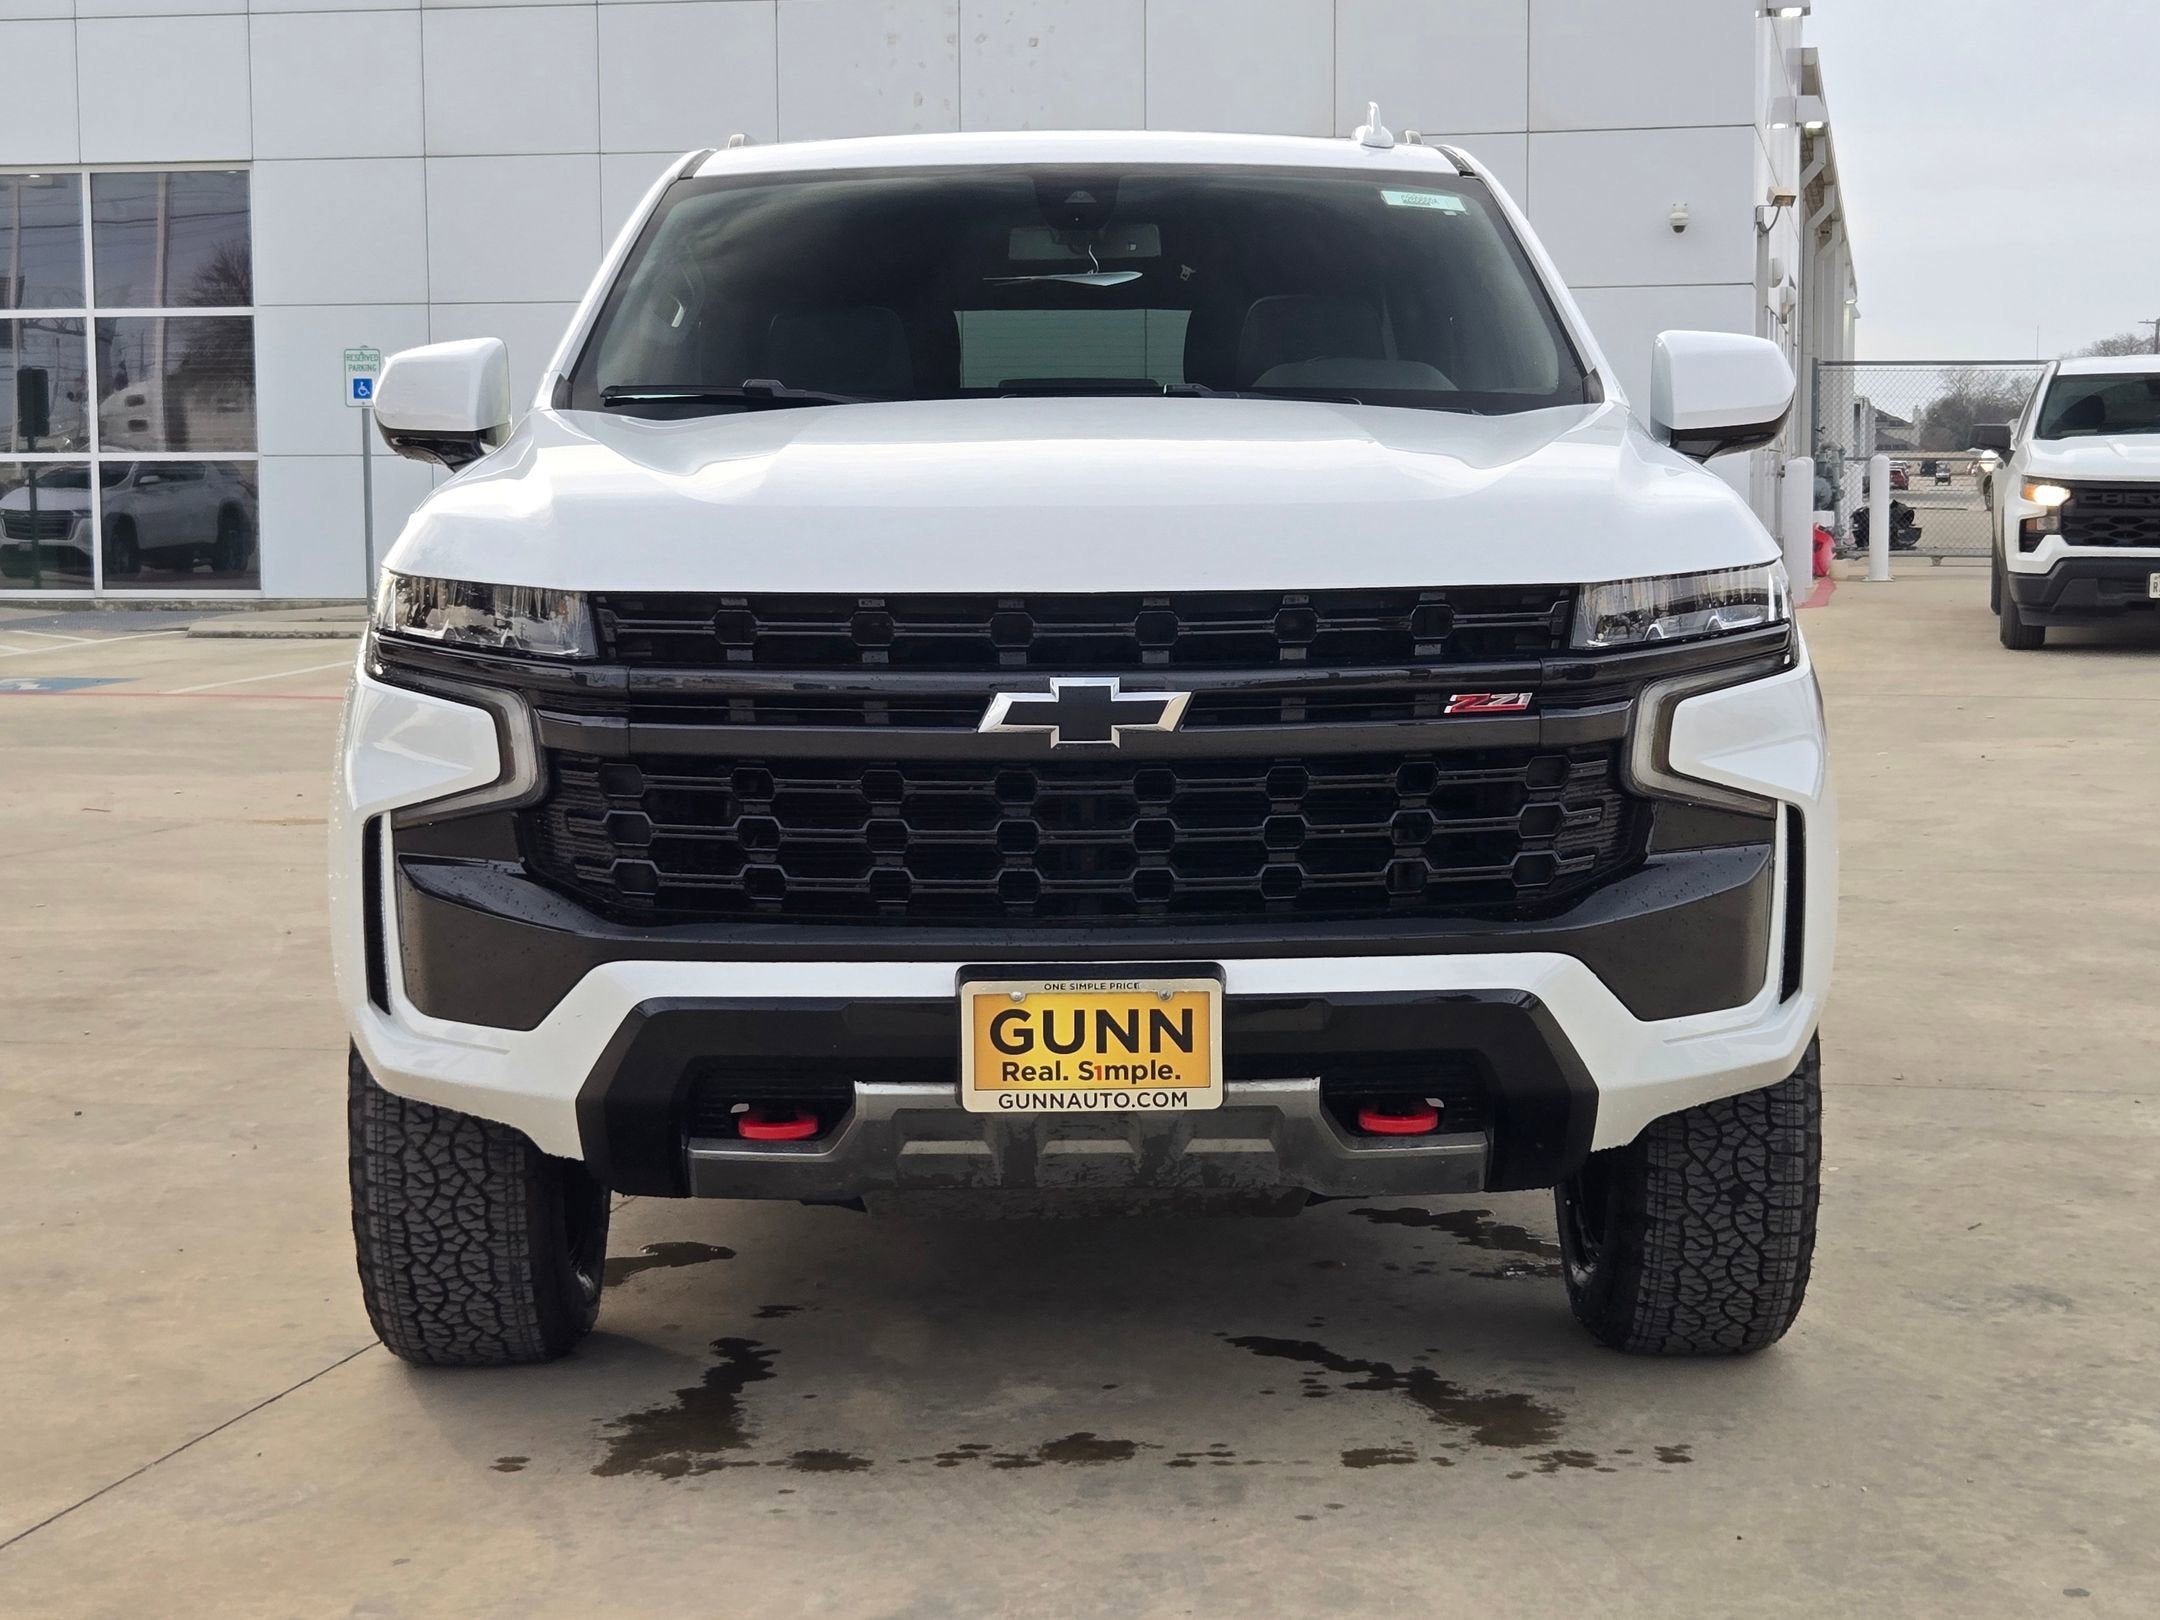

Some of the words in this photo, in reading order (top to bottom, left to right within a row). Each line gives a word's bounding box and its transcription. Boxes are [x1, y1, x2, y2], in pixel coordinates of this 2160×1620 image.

[1444, 693, 1533, 713] Z71
[1044, 982, 1066, 991] ONE
[1069, 982, 1107, 990] SIMPLE
[1109, 982, 1140, 990] PRICE
[989, 1008, 1194, 1055] GUNN
[1001, 1060, 1069, 1082] Real.
[998, 1091, 1188, 1110] GUNNAUTO.COM
